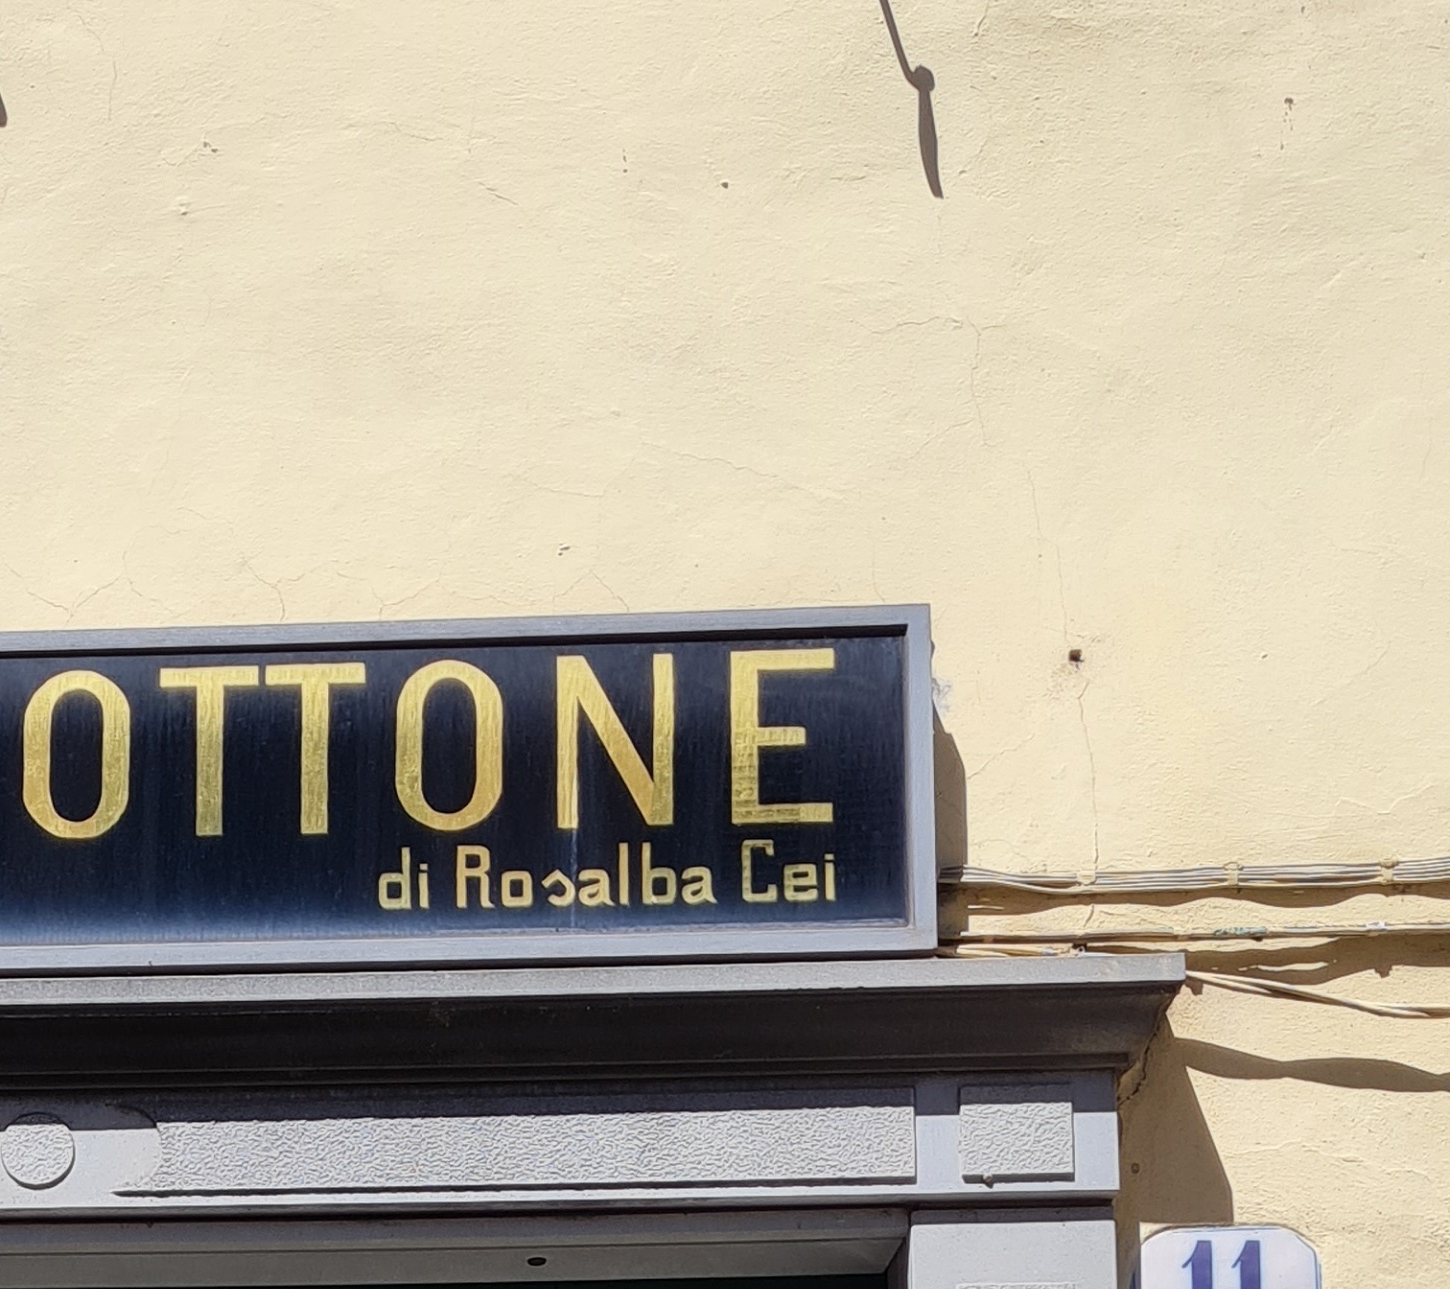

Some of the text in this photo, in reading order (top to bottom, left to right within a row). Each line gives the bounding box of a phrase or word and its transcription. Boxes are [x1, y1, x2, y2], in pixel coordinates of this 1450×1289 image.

[378, 839, 836, 910] di Rosalba Cei
